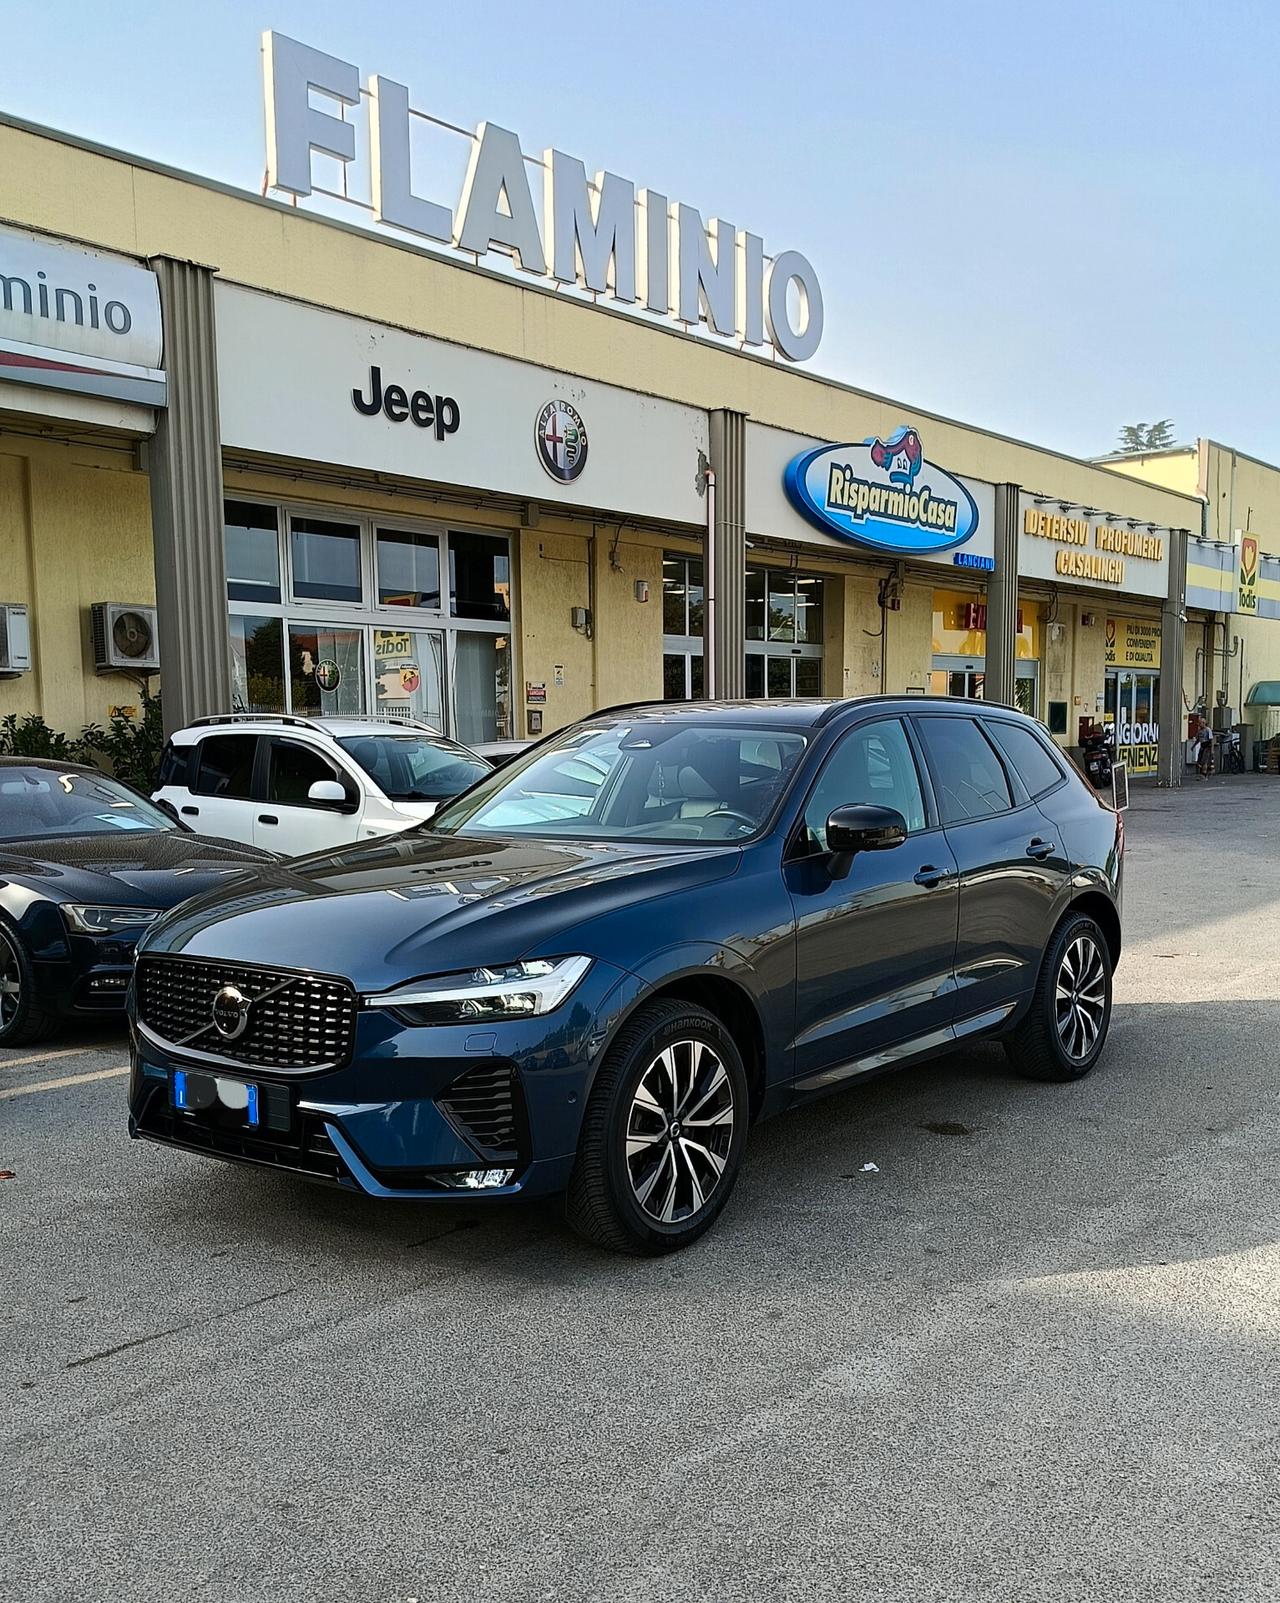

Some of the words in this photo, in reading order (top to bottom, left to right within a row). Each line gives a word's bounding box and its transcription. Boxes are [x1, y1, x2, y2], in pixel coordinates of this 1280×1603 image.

[261, 30, 824, 362] FLAMINIO
[351, 365, 461, 441] Jeep
[539, 403, 556, 438] ALFA
[560, 402, 587, 446] ROMEO
[828, 463, 958, 532] RisparmioCasa
[1096, 526, 1164, 561] PROFUMERIA
[1239, 587, 1256, 609] Todis
[1105, 650, 1116, 662] odis
